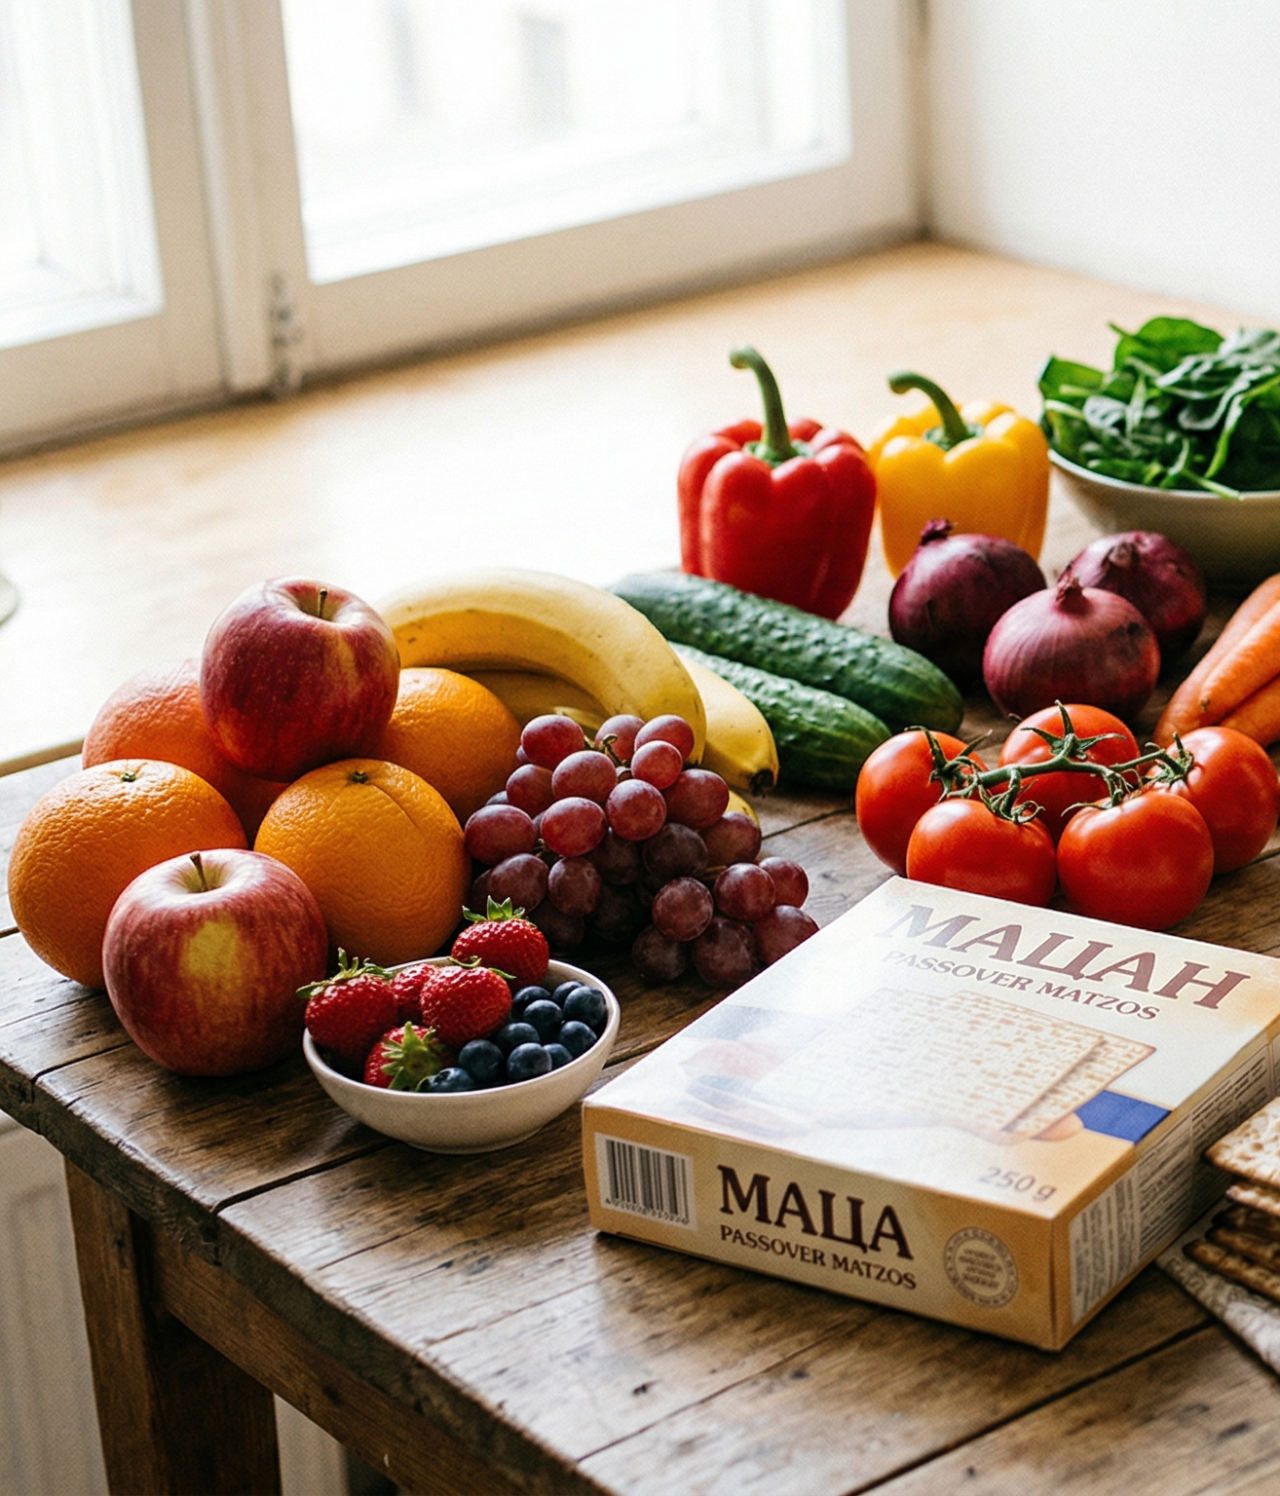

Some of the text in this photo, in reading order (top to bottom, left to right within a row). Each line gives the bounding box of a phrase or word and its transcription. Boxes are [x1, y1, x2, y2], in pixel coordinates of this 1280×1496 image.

[881, 950, 1160, 1021] PASSOVER MATZOS
[717, 1164, 915, 1261] МАЦА
[978, 1166, 1057, 1202] 250 g
[720, 1225, 826, 1266] PASSOVER
[831, 1253, 918, 1290] MATZOS
